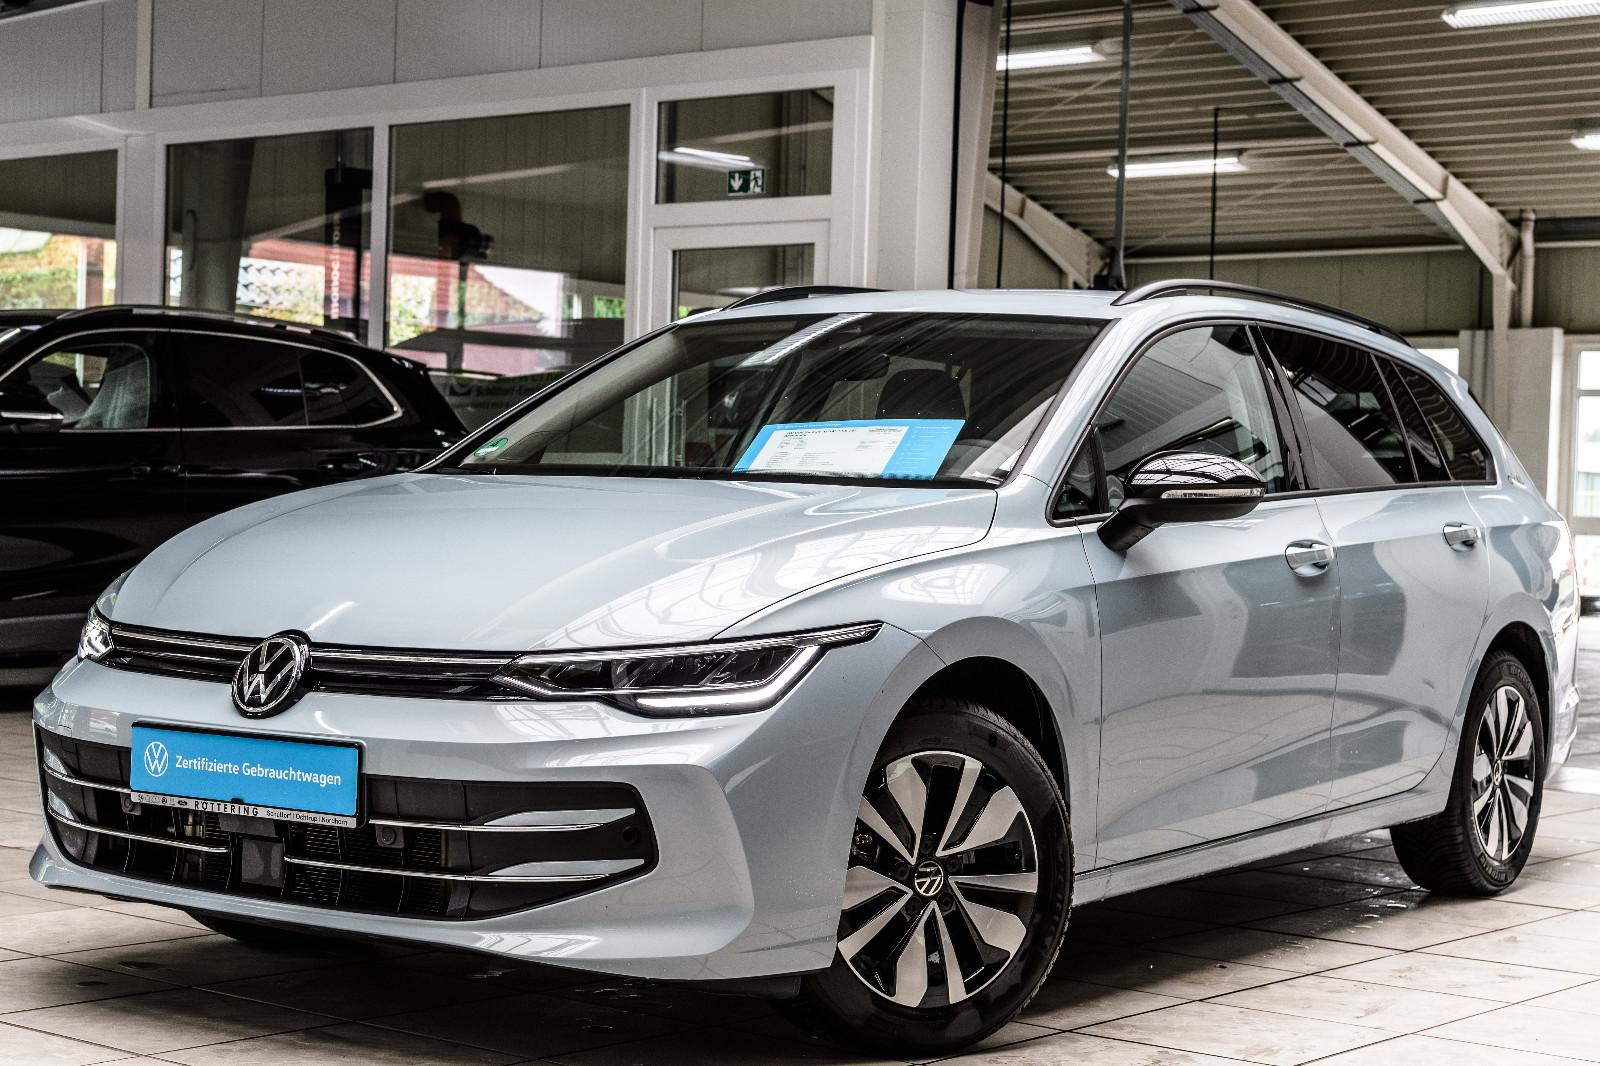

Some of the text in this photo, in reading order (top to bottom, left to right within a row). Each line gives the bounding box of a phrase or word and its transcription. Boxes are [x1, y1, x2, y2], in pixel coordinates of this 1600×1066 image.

[175, 756, 341, 787] Zertifizierte Gebrauchtwagen
[194, 800, 259, 816] RÖTTERING
